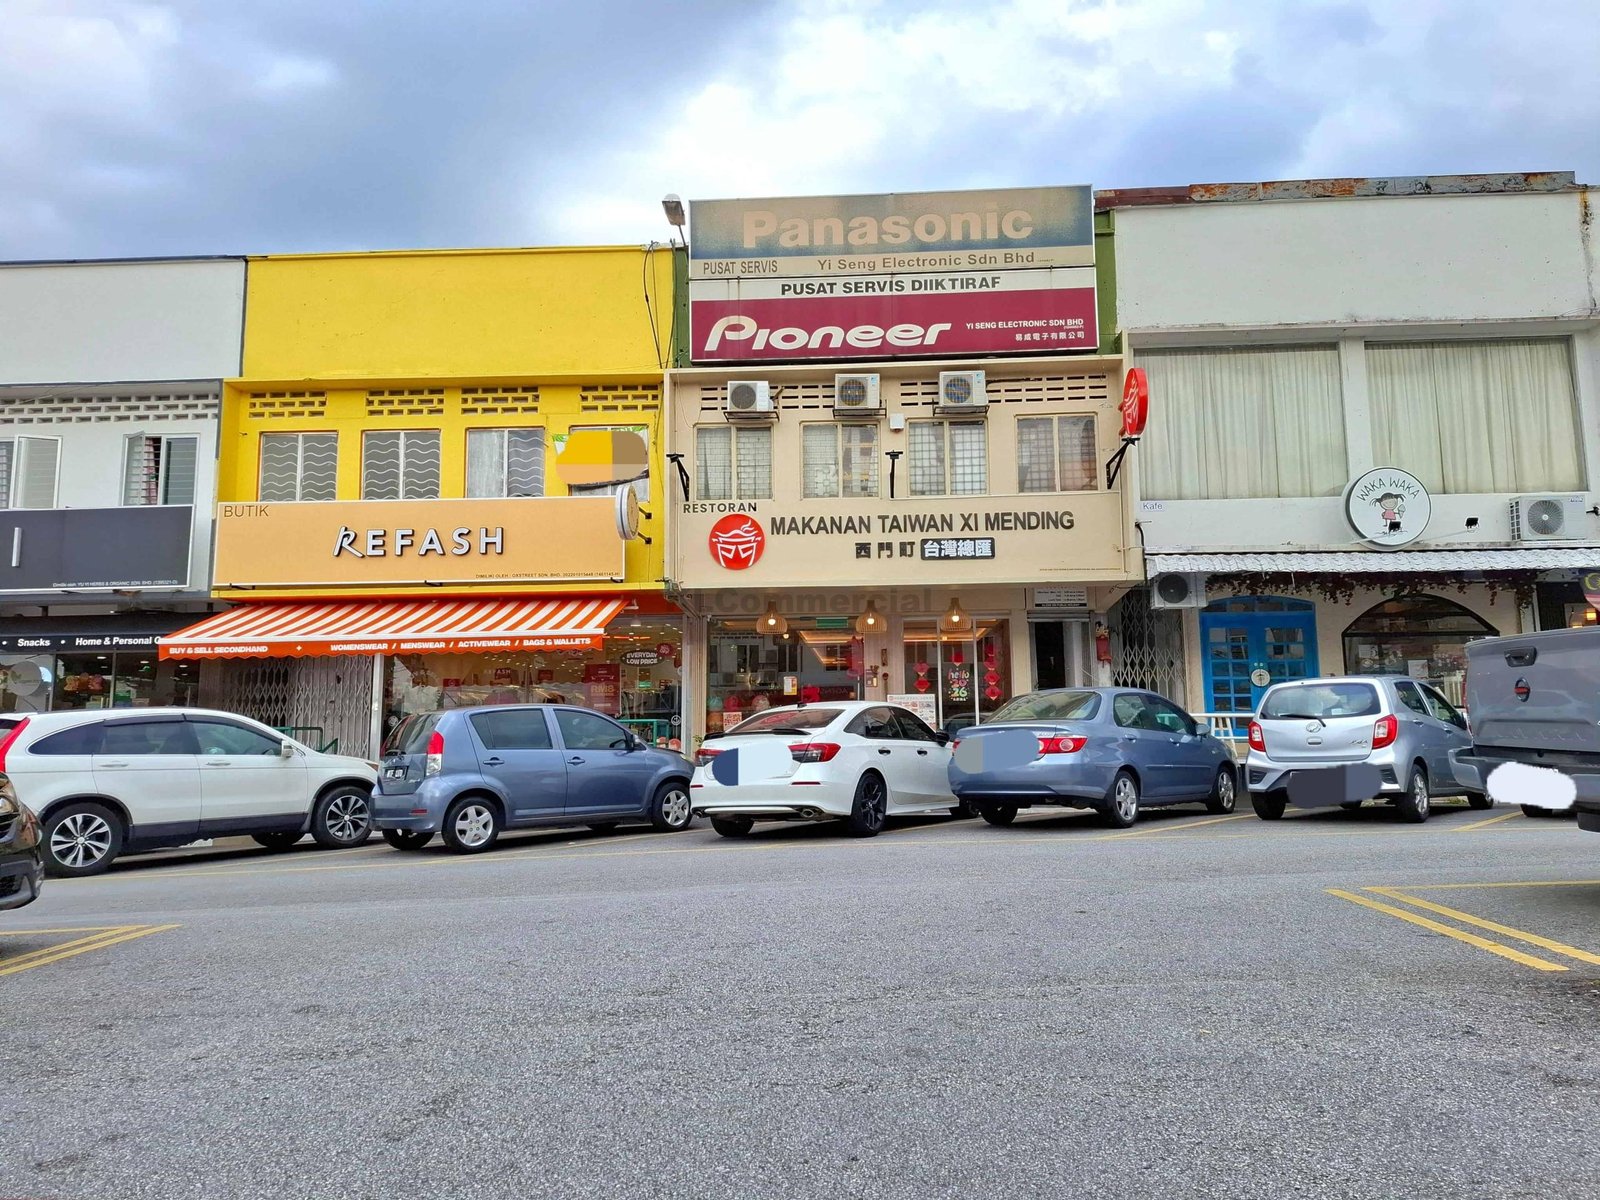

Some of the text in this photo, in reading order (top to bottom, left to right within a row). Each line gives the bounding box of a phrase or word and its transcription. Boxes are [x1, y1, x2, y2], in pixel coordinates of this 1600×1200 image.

[743, 206, 1033, 249] Panasonic
[703, 260, 778, 275] PUSAT SERVIS
[817, 252, 1035, 271] Yi Seng Electronic Sdn Bhd
[781, 276, 1001, 296] PUSAT SERVIS DIIKTIRAF
[998, 319, 1047, 329] ELECTRONIC
[1049, 319, 1065, 327] SDN
[1066, 318, 1084, 326] BHD
[703, 315, 952, 351] Pioneer
[1356, 477, 1420, 501] WAKA WAKA
[223, 505, 269, 517] BUTIK
[683, 502, 757, 513] RESTORAN
[1142, 502, 1163, 510] Kafe
[771, 511, 1075, 535] MAKANAN TAIWAN XI MENDING
[332, 525, 504, 558] REFASH
[855, 539, 993, 559] 西門町 台灣總匯
[17, 638, 51, 647] Snacks
[75, 637, 102, 646] Home
[103, 637, 111, 645] &
[112, 636, 152, 645] Personal
[331, 643, 388, 651] WOMENSWEAR
[400, 641, 446, 650] MENSWEAR
[458, 640, 511, 648] ACTIVEWEAR
[553, 638, 591, 646] WALLETS
[214, 645, 269, 653] SECONDHAND
[948, 669, 970, 680] hello
[951, 687, 968, 697] 26
